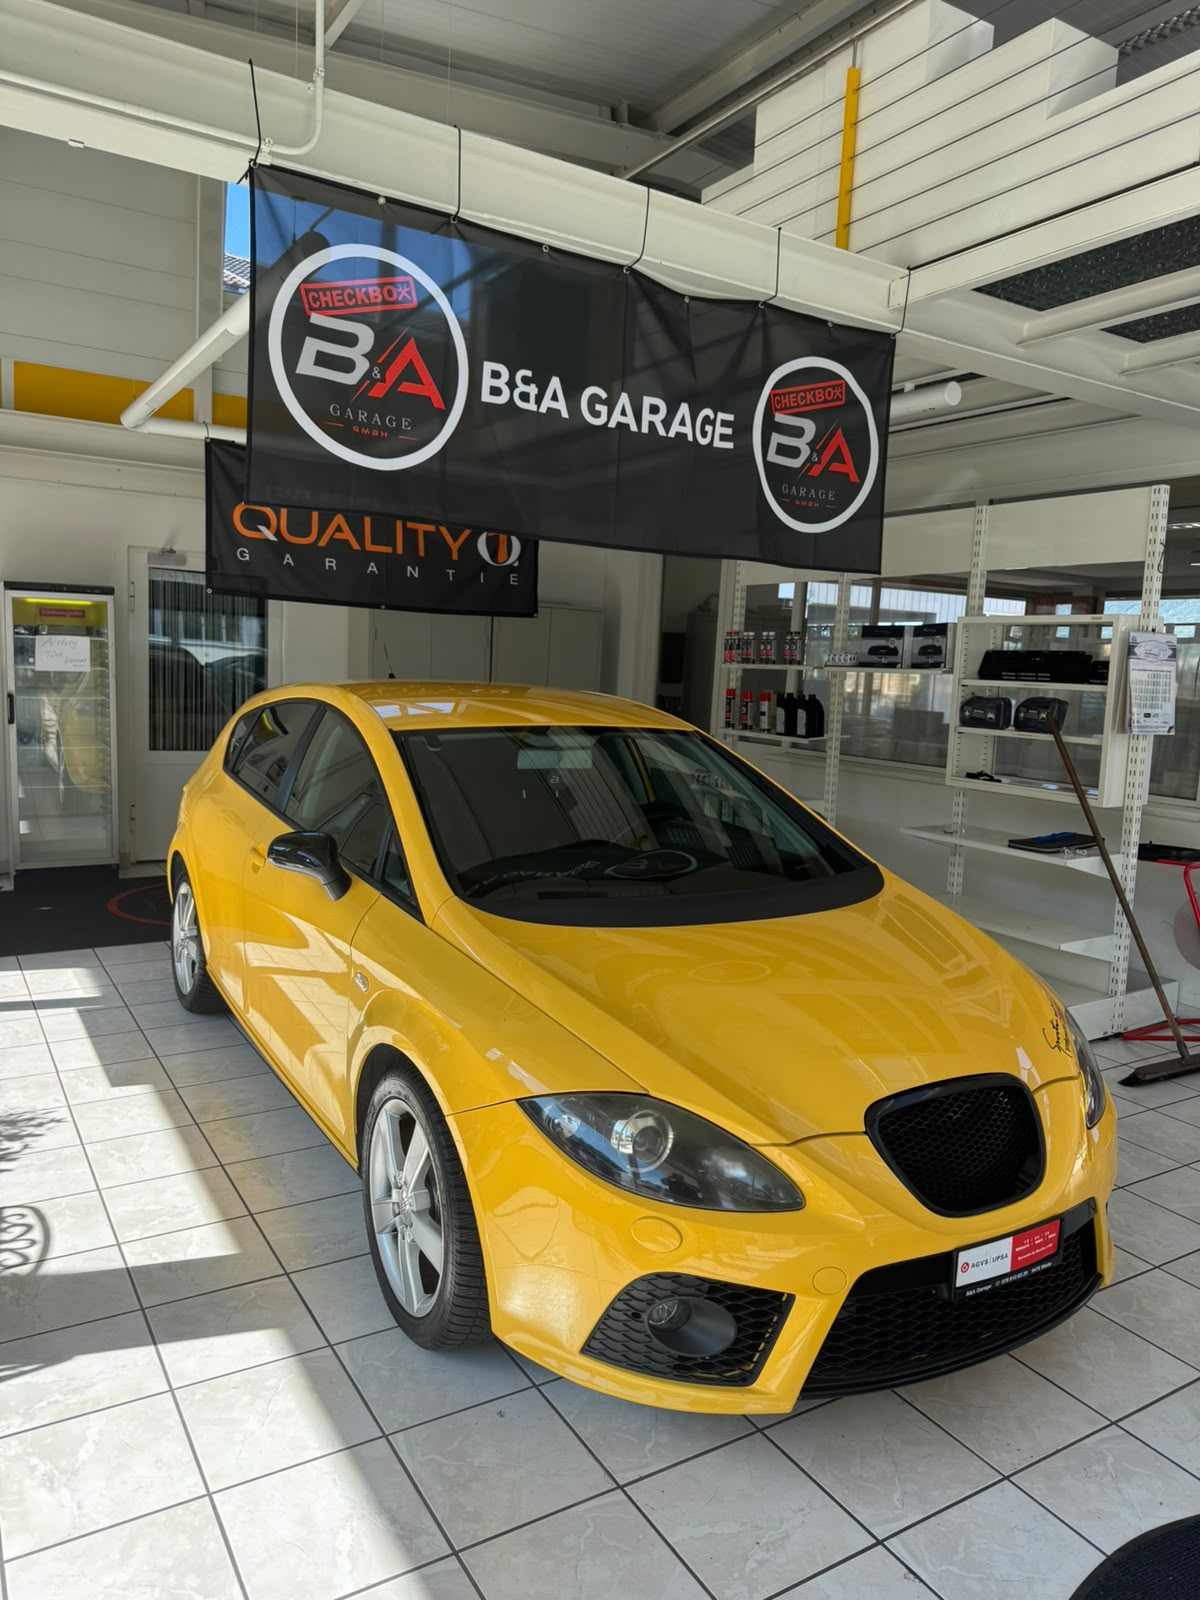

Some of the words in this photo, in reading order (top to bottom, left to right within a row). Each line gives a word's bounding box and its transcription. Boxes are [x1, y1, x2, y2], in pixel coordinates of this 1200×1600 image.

[329, 403, 412, 431] GARAGE
[480, 360, 570, 419] B&A
[579, 385, 735, 449] GARAGE
[781, 483, 836, 501] GARAGE
[232, 502, 473, 561] QUALITY
[236, 547, 519, 585] GARANTIE
[970, 1258, 989, 1269] AGVS
[992, 1252, 1009, 1263] UPSA
